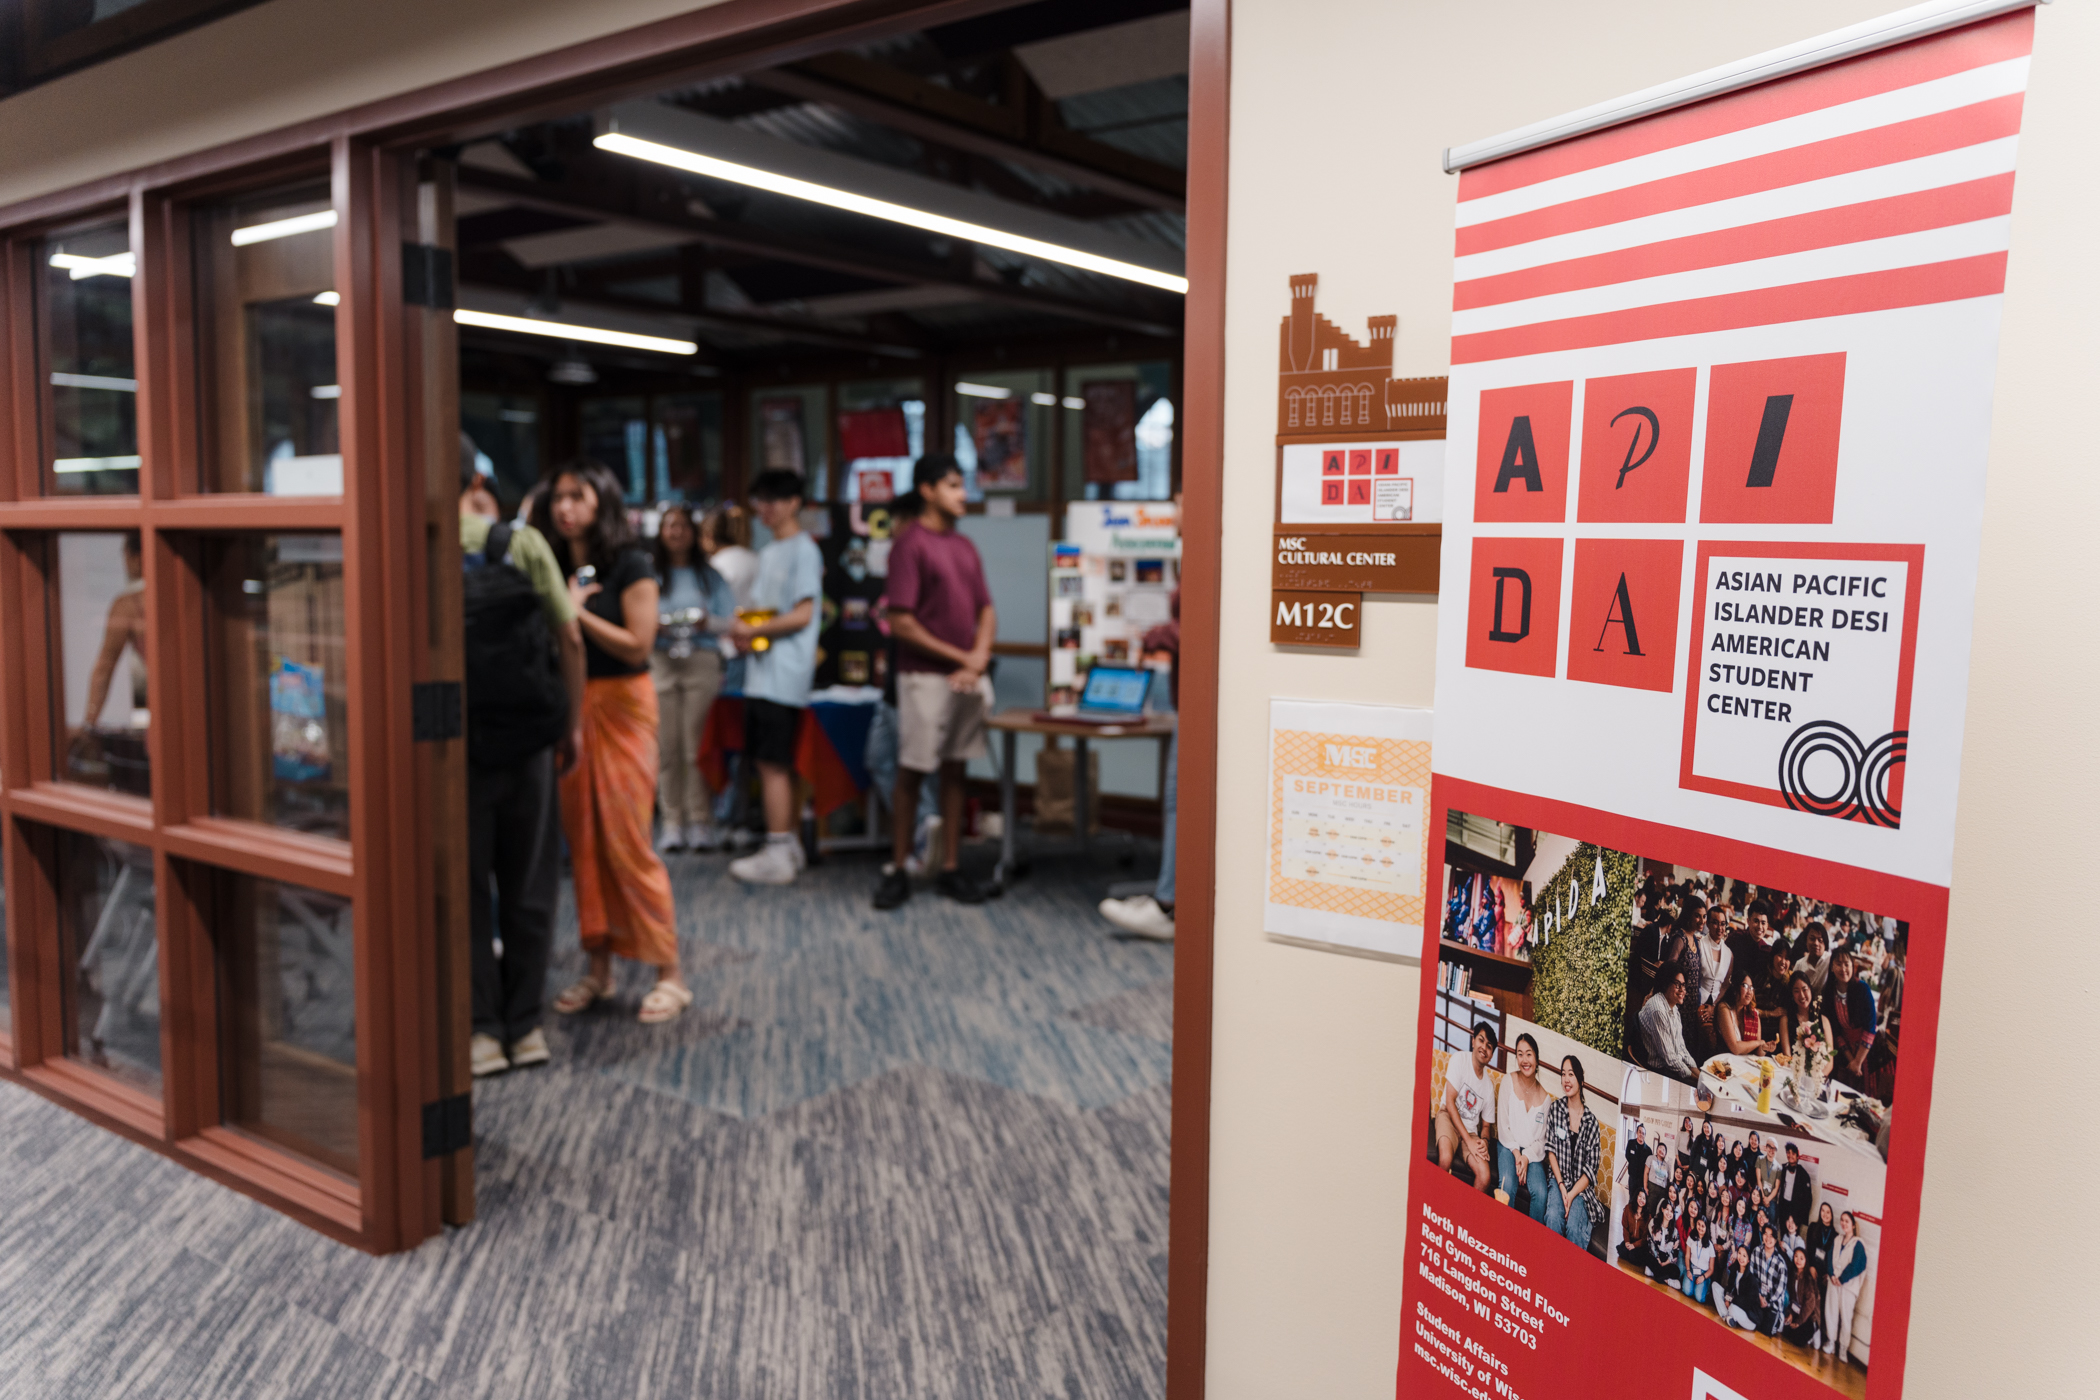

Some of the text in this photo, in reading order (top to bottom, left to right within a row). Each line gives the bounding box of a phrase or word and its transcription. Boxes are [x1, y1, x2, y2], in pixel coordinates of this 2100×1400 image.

[1278, 551, 1396, 566] CULTURAL CENTER
[1279, 537, 1307, 551] MSC
[1715, 571, 1887, 598] ASIAN PACIFIC
[1276, 601, 1354, 629] M12C
[1714, 602, 1888, 632] ISLANDER DESI
[1711, 632, 1830, 662] AMERICAN
[1709, 663, 1813, 692] STUDENT
[1707, 693, 1792, 723] CENTER
[1324, 744, 1377, 769] MSC
[1294, 779, 1413, 805] SEPTEMBER
[1348, 801, 1372, 810] HOURS
[1423, 1202, 1528, 1277] North Mezzanine
[1420, 1242, 1544, 1333] 716 Langdon Street
[1421, 1222, 1570, 1327] Red Gym, Second Floor
[1419, 1262, 1537, 1350] Madison, WI 53703
[1416, 1301, 1509, 1376] Student Affairs
[1414, 1342, 1492, 1400] msc.wisc.ed
[1416, 1320, 1524, 1400] University of Wis
